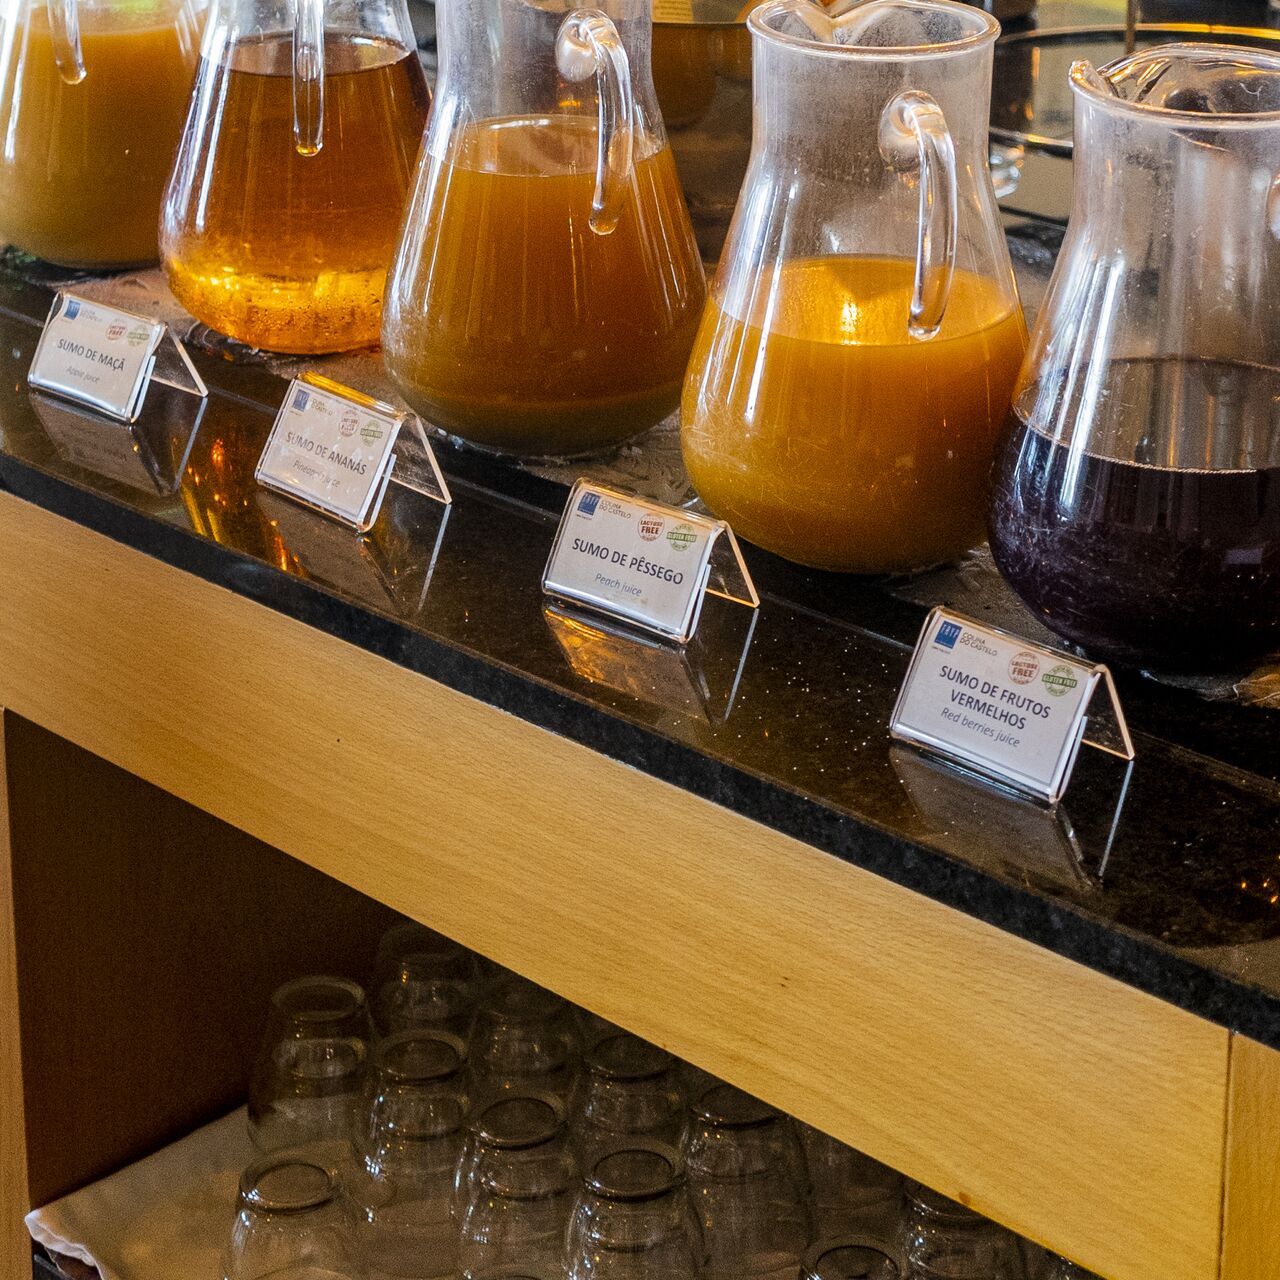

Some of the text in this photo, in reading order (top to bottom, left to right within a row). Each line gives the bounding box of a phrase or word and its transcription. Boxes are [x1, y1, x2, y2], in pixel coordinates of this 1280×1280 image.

[57, 338, 126, 372] SUMO DE MAÇÃ
[287, 431, 367, 475] SUMO DE ANANÁS
[640, 525, 661, 536] FREE
[572, 537, 684, 585] SUMO DE PÊSSEGO
[595, 572, 643, 597] Peach juice
[959, 637, 998, 657] DO CASTELO
[939, 665, 1052, 719] SUMO DE FRUTOS
[1012, 668, 1034, 679] FREE
[940, 707, 1021, 748] Red berries juice
[950, 689, 1027, 730] VERMELHOS
